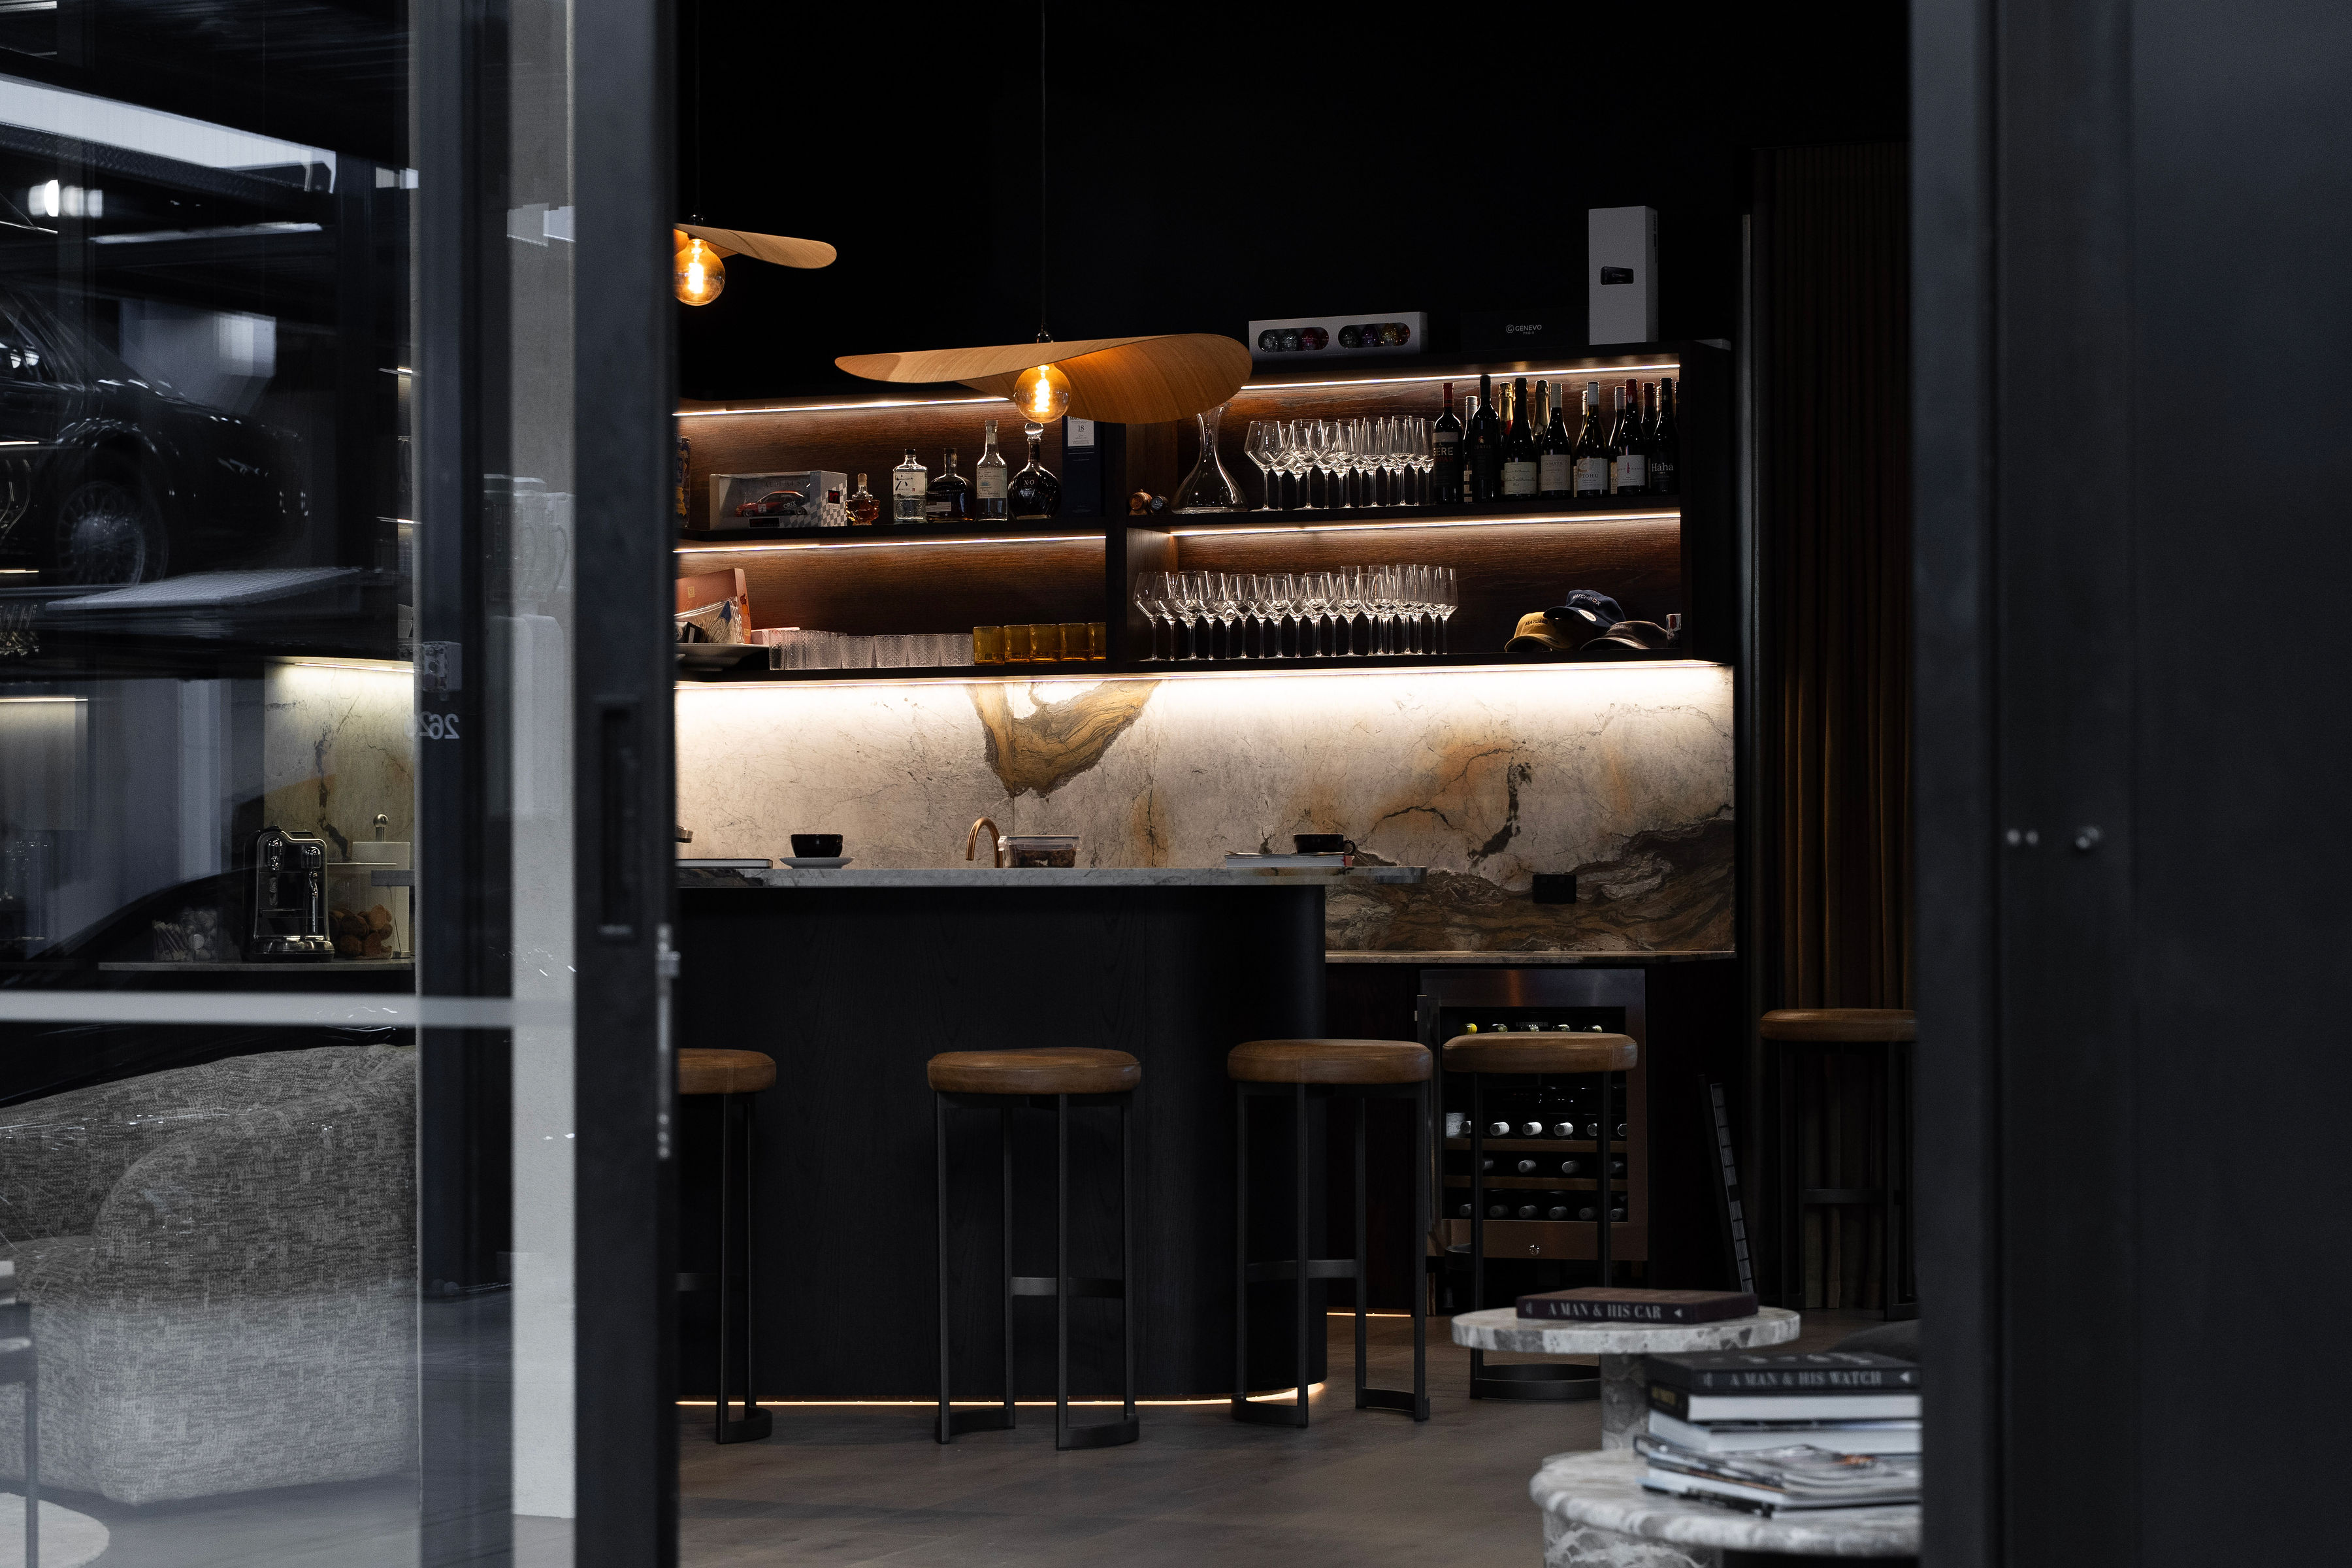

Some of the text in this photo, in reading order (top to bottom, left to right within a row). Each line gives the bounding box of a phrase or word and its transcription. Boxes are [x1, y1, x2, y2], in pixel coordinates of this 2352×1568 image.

[783, 500, 797, 509] ORIX
[1573, 593, 1601, 606] MATCHBOX
[1548, 1302, 1662, 1320] A MAN & HIS CAR
[1729, 1370, 1882, 1386] A MAN & HIS WATCH
